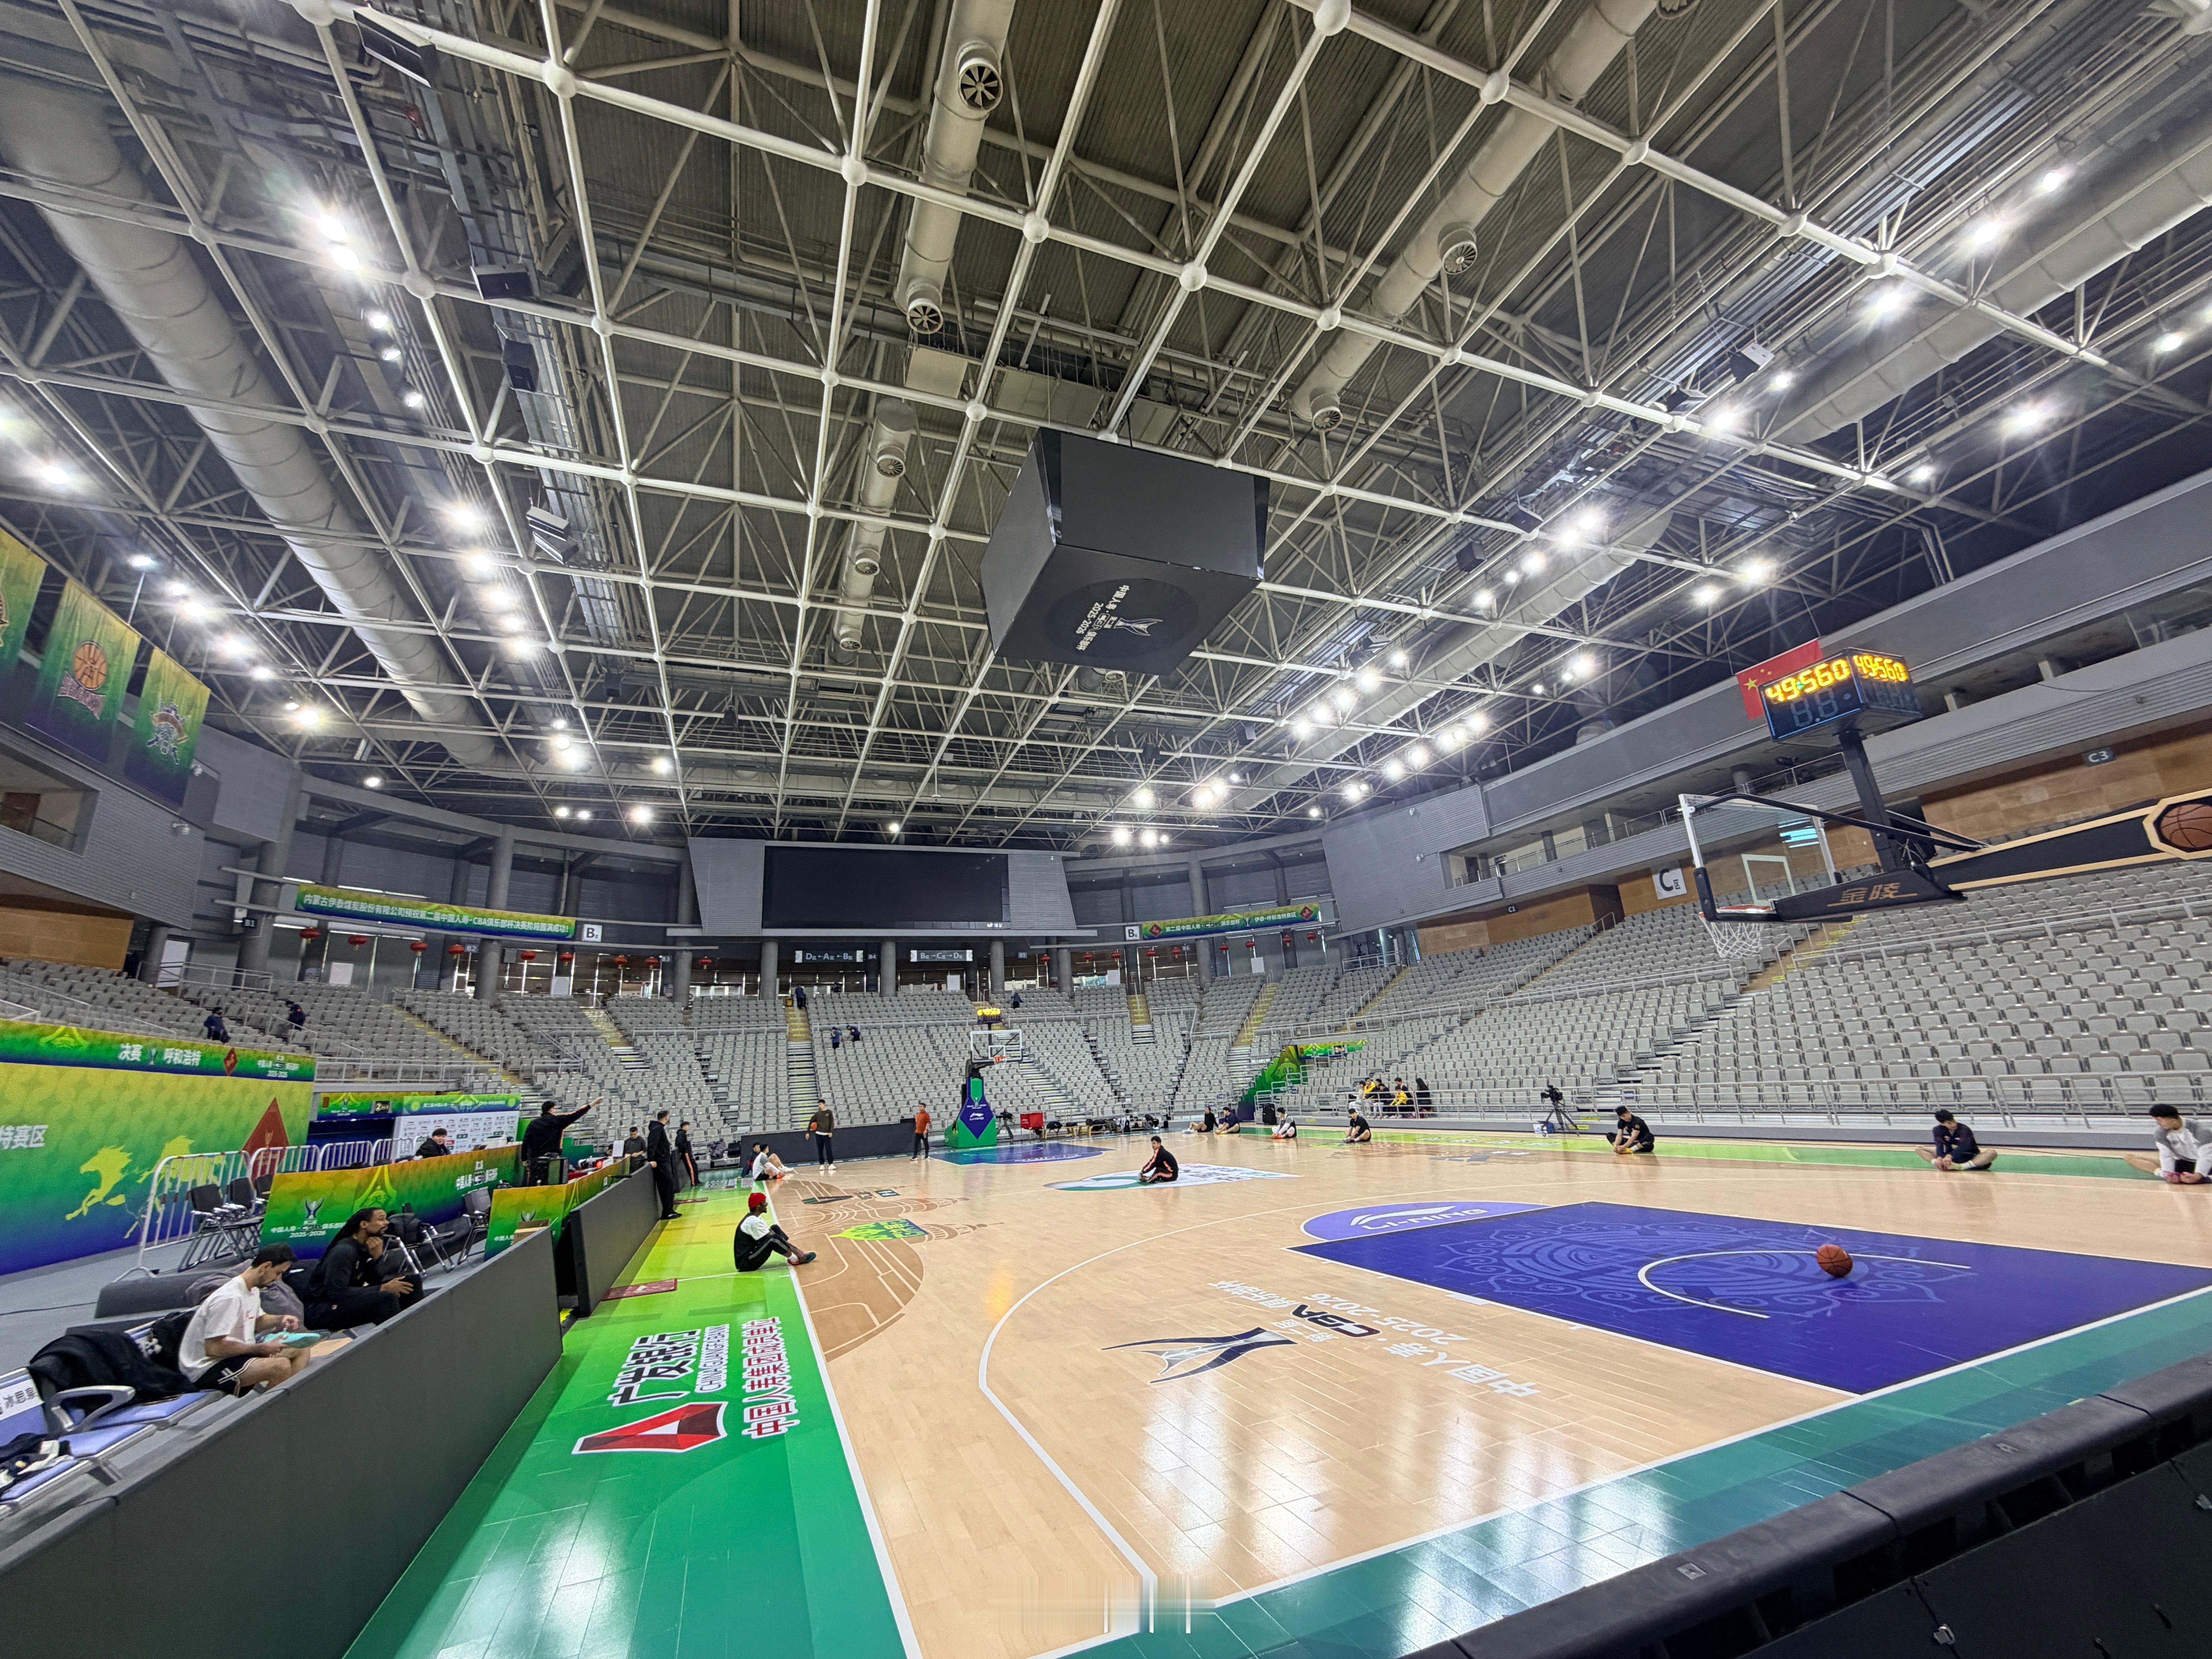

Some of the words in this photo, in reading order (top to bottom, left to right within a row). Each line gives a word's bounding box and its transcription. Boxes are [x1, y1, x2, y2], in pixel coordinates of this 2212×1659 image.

[2088, 750, 2109, 763] C3
[1659, 868, 1679, 892] C区
[118, 1043, 143, 1062] 决赛
[163, 1047, 202, 1067] 呼和浩特
[1361, 1208, 1489, 1229] LI-NING
[1269, 1319, 1340, 1343] 第二届
[1302, 1293, 1468, 1346] 2025-2026
[614, 1329, 700, 1405] 广发银行
[699, 1367, 722, 1391] CHINA
[743, 1318, 799, 1436] 中国人寿集团成员单位
